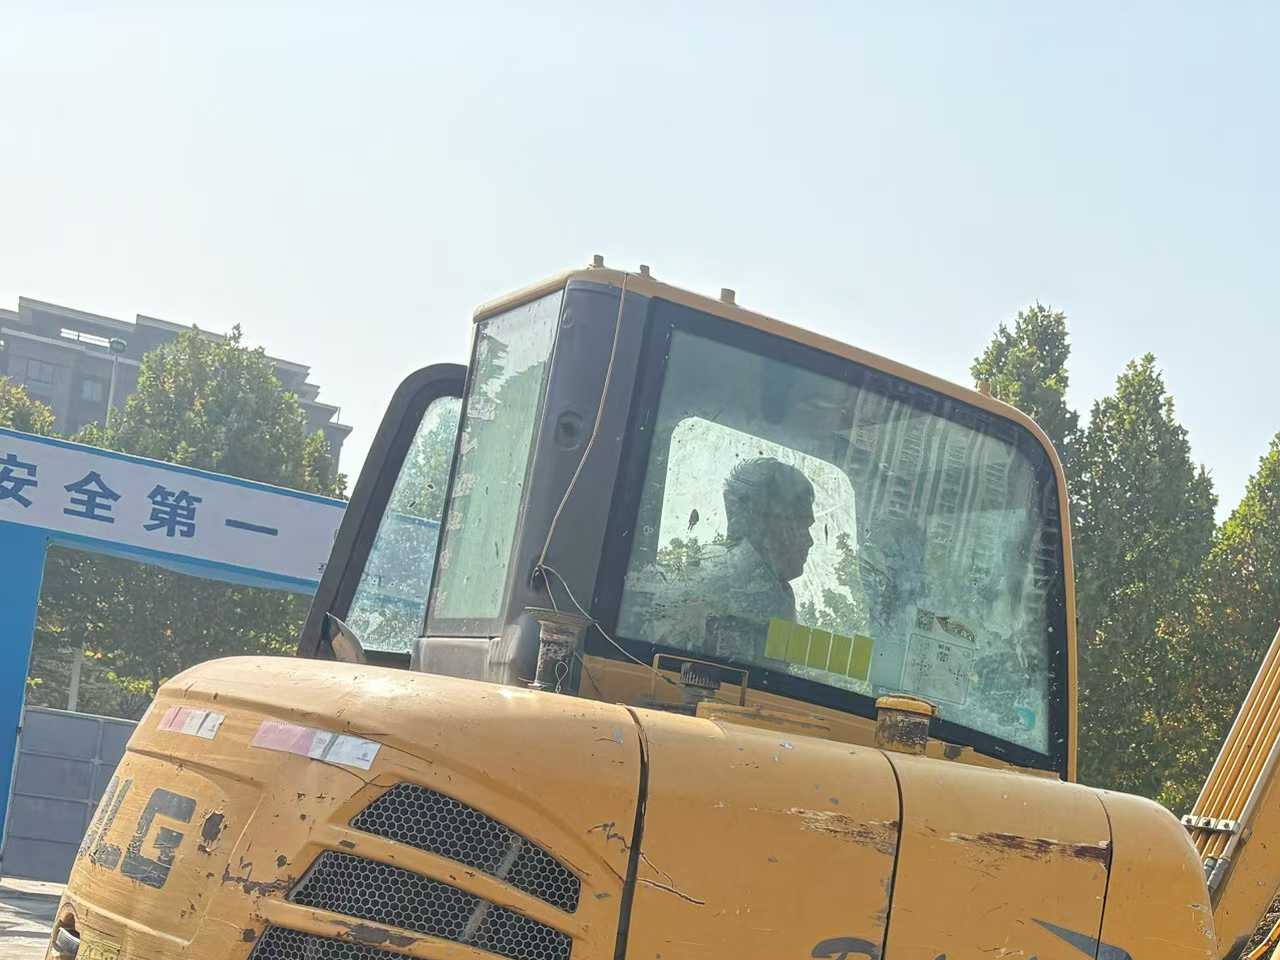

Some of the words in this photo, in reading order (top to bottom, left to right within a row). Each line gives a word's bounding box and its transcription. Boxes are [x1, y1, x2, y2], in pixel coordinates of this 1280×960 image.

[0, 453, 279, 538] 安全第一
[78, 776, 197, 890] LG
